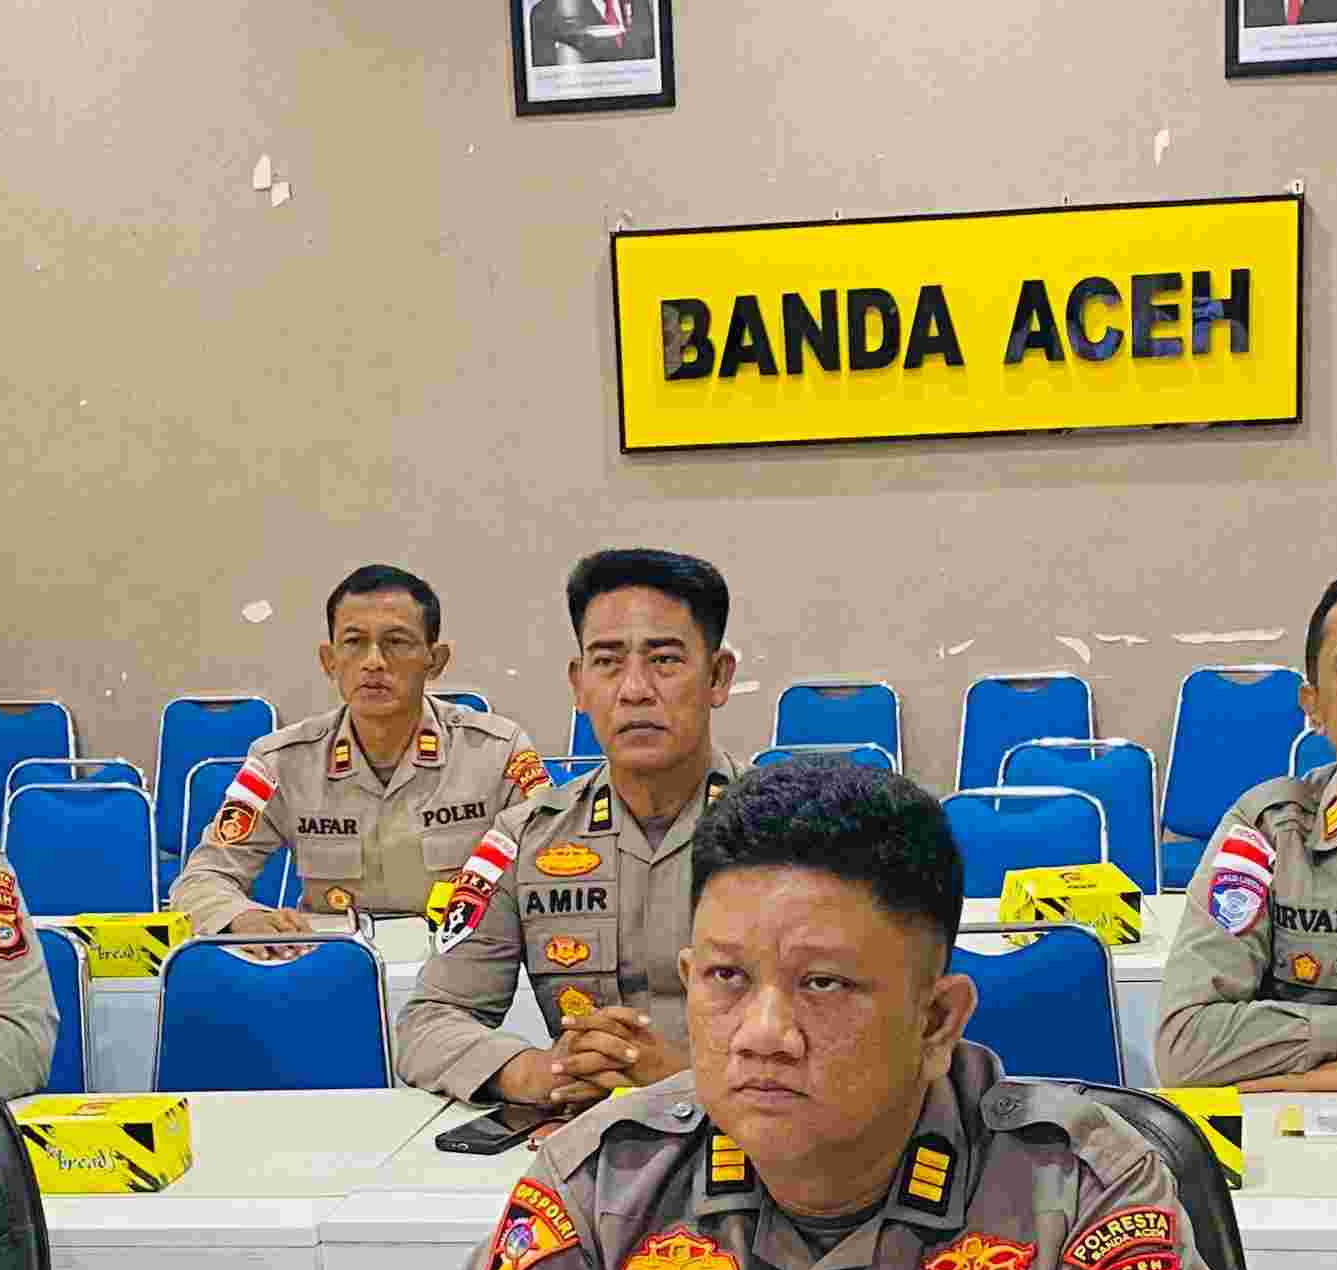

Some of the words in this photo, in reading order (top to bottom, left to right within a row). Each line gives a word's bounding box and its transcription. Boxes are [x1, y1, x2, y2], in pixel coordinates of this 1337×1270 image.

[662, 283, 963, 382] BANDA
[1003, 267, 1252, 366] ACEH
[297, 816, 358, 835] JAFAR
[422, 801, 487, 828] POLRI
[526, 887, 608, 914] AMIR
[1071, 1212, 1169, 1262] POLRESTA
